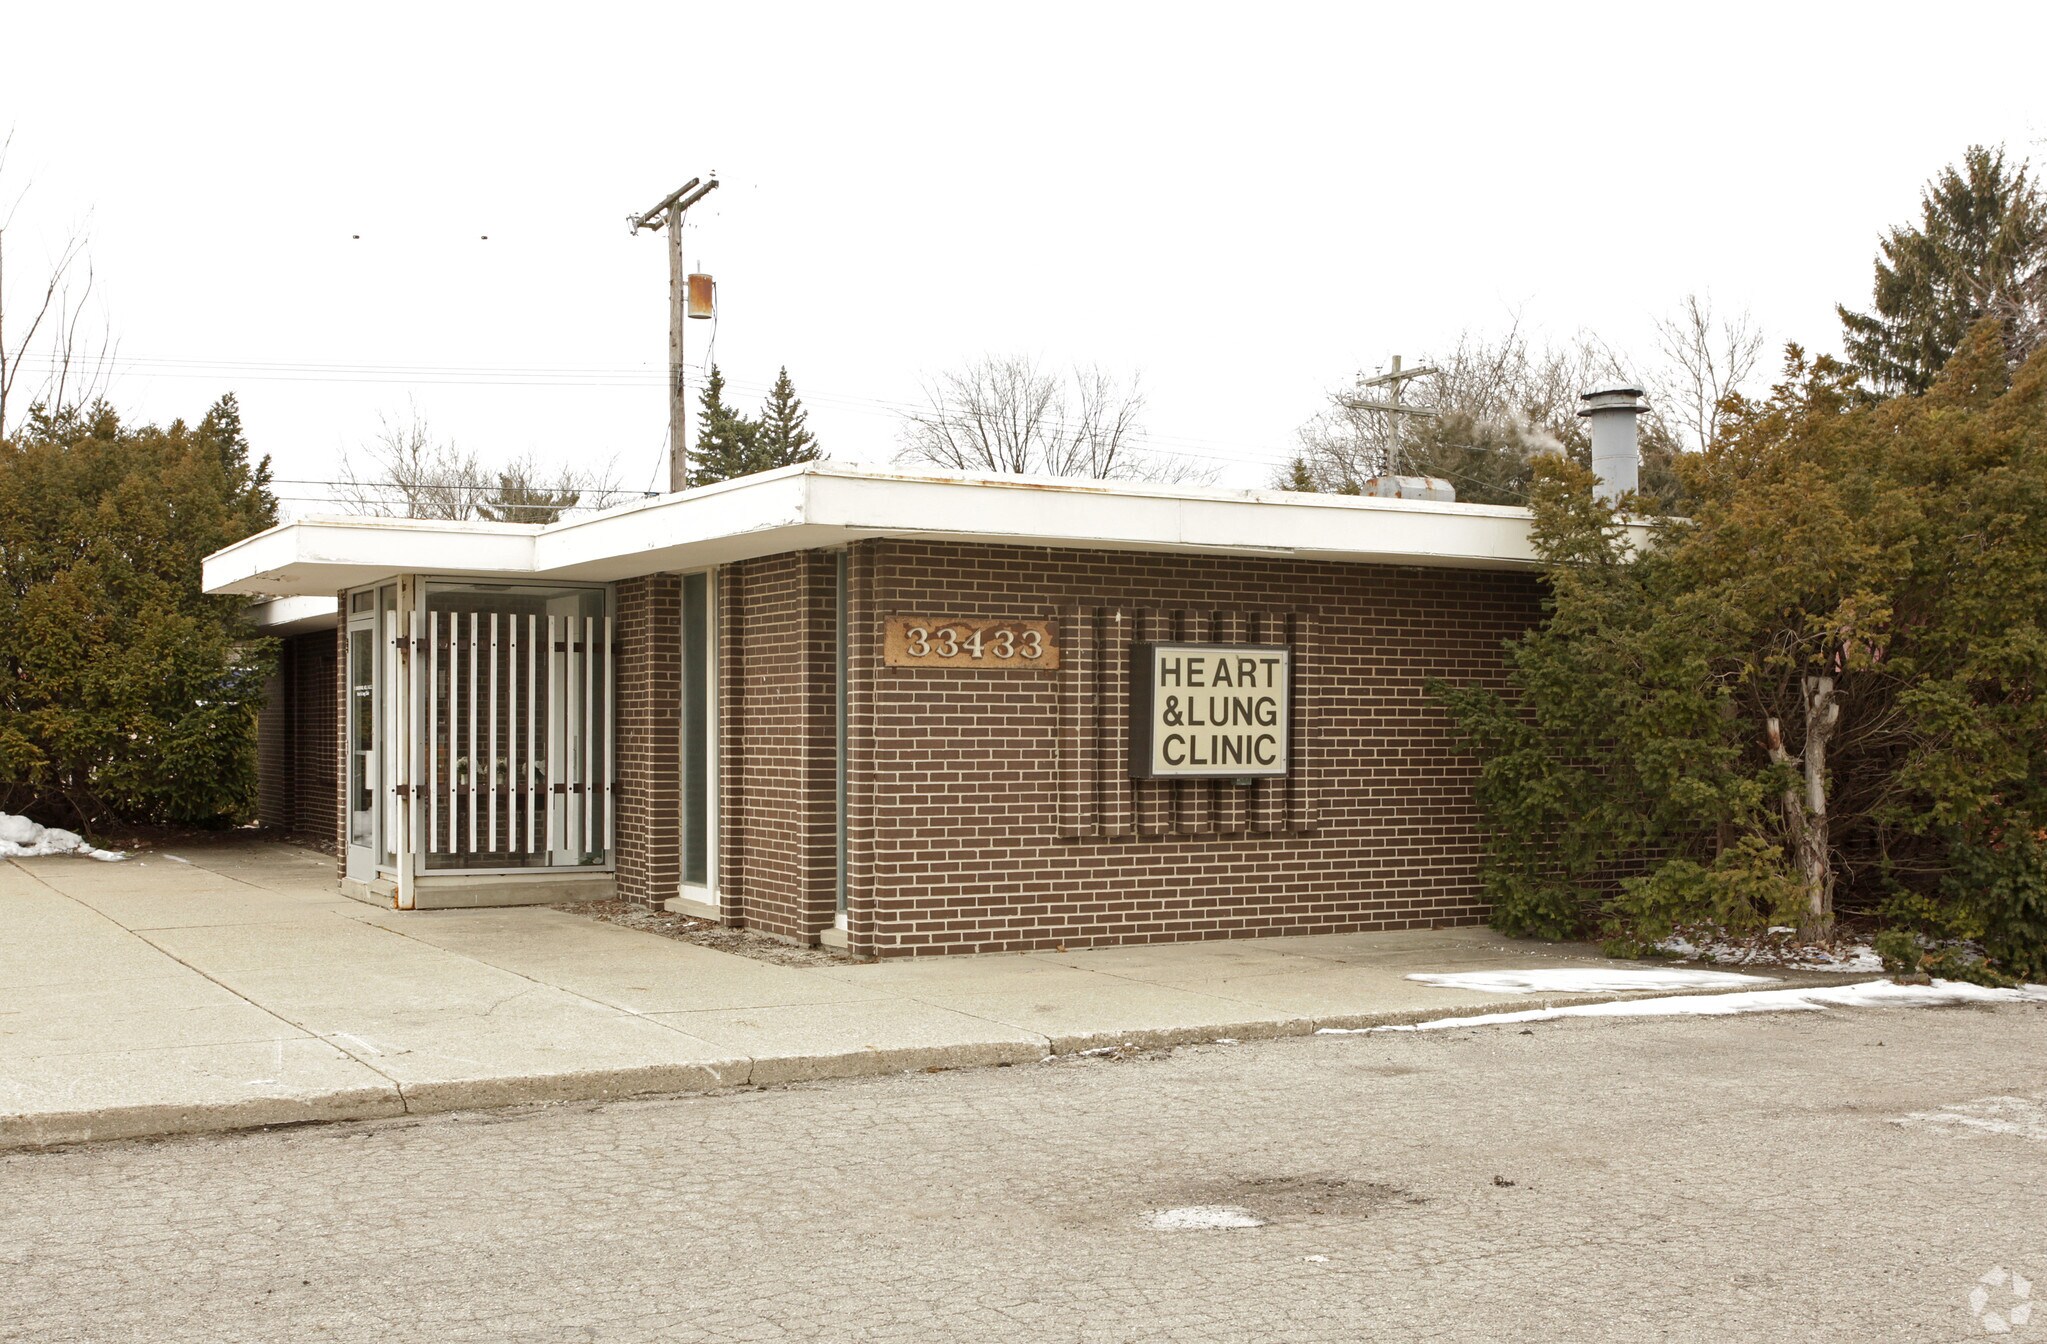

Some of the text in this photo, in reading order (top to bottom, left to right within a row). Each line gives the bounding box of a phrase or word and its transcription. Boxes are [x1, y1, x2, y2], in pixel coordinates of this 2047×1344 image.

[907, 627, 1043, 659] 33433
[1160, 657, 1280, 688] HEART
[1162, 733, 1276, 766] CLINIC
